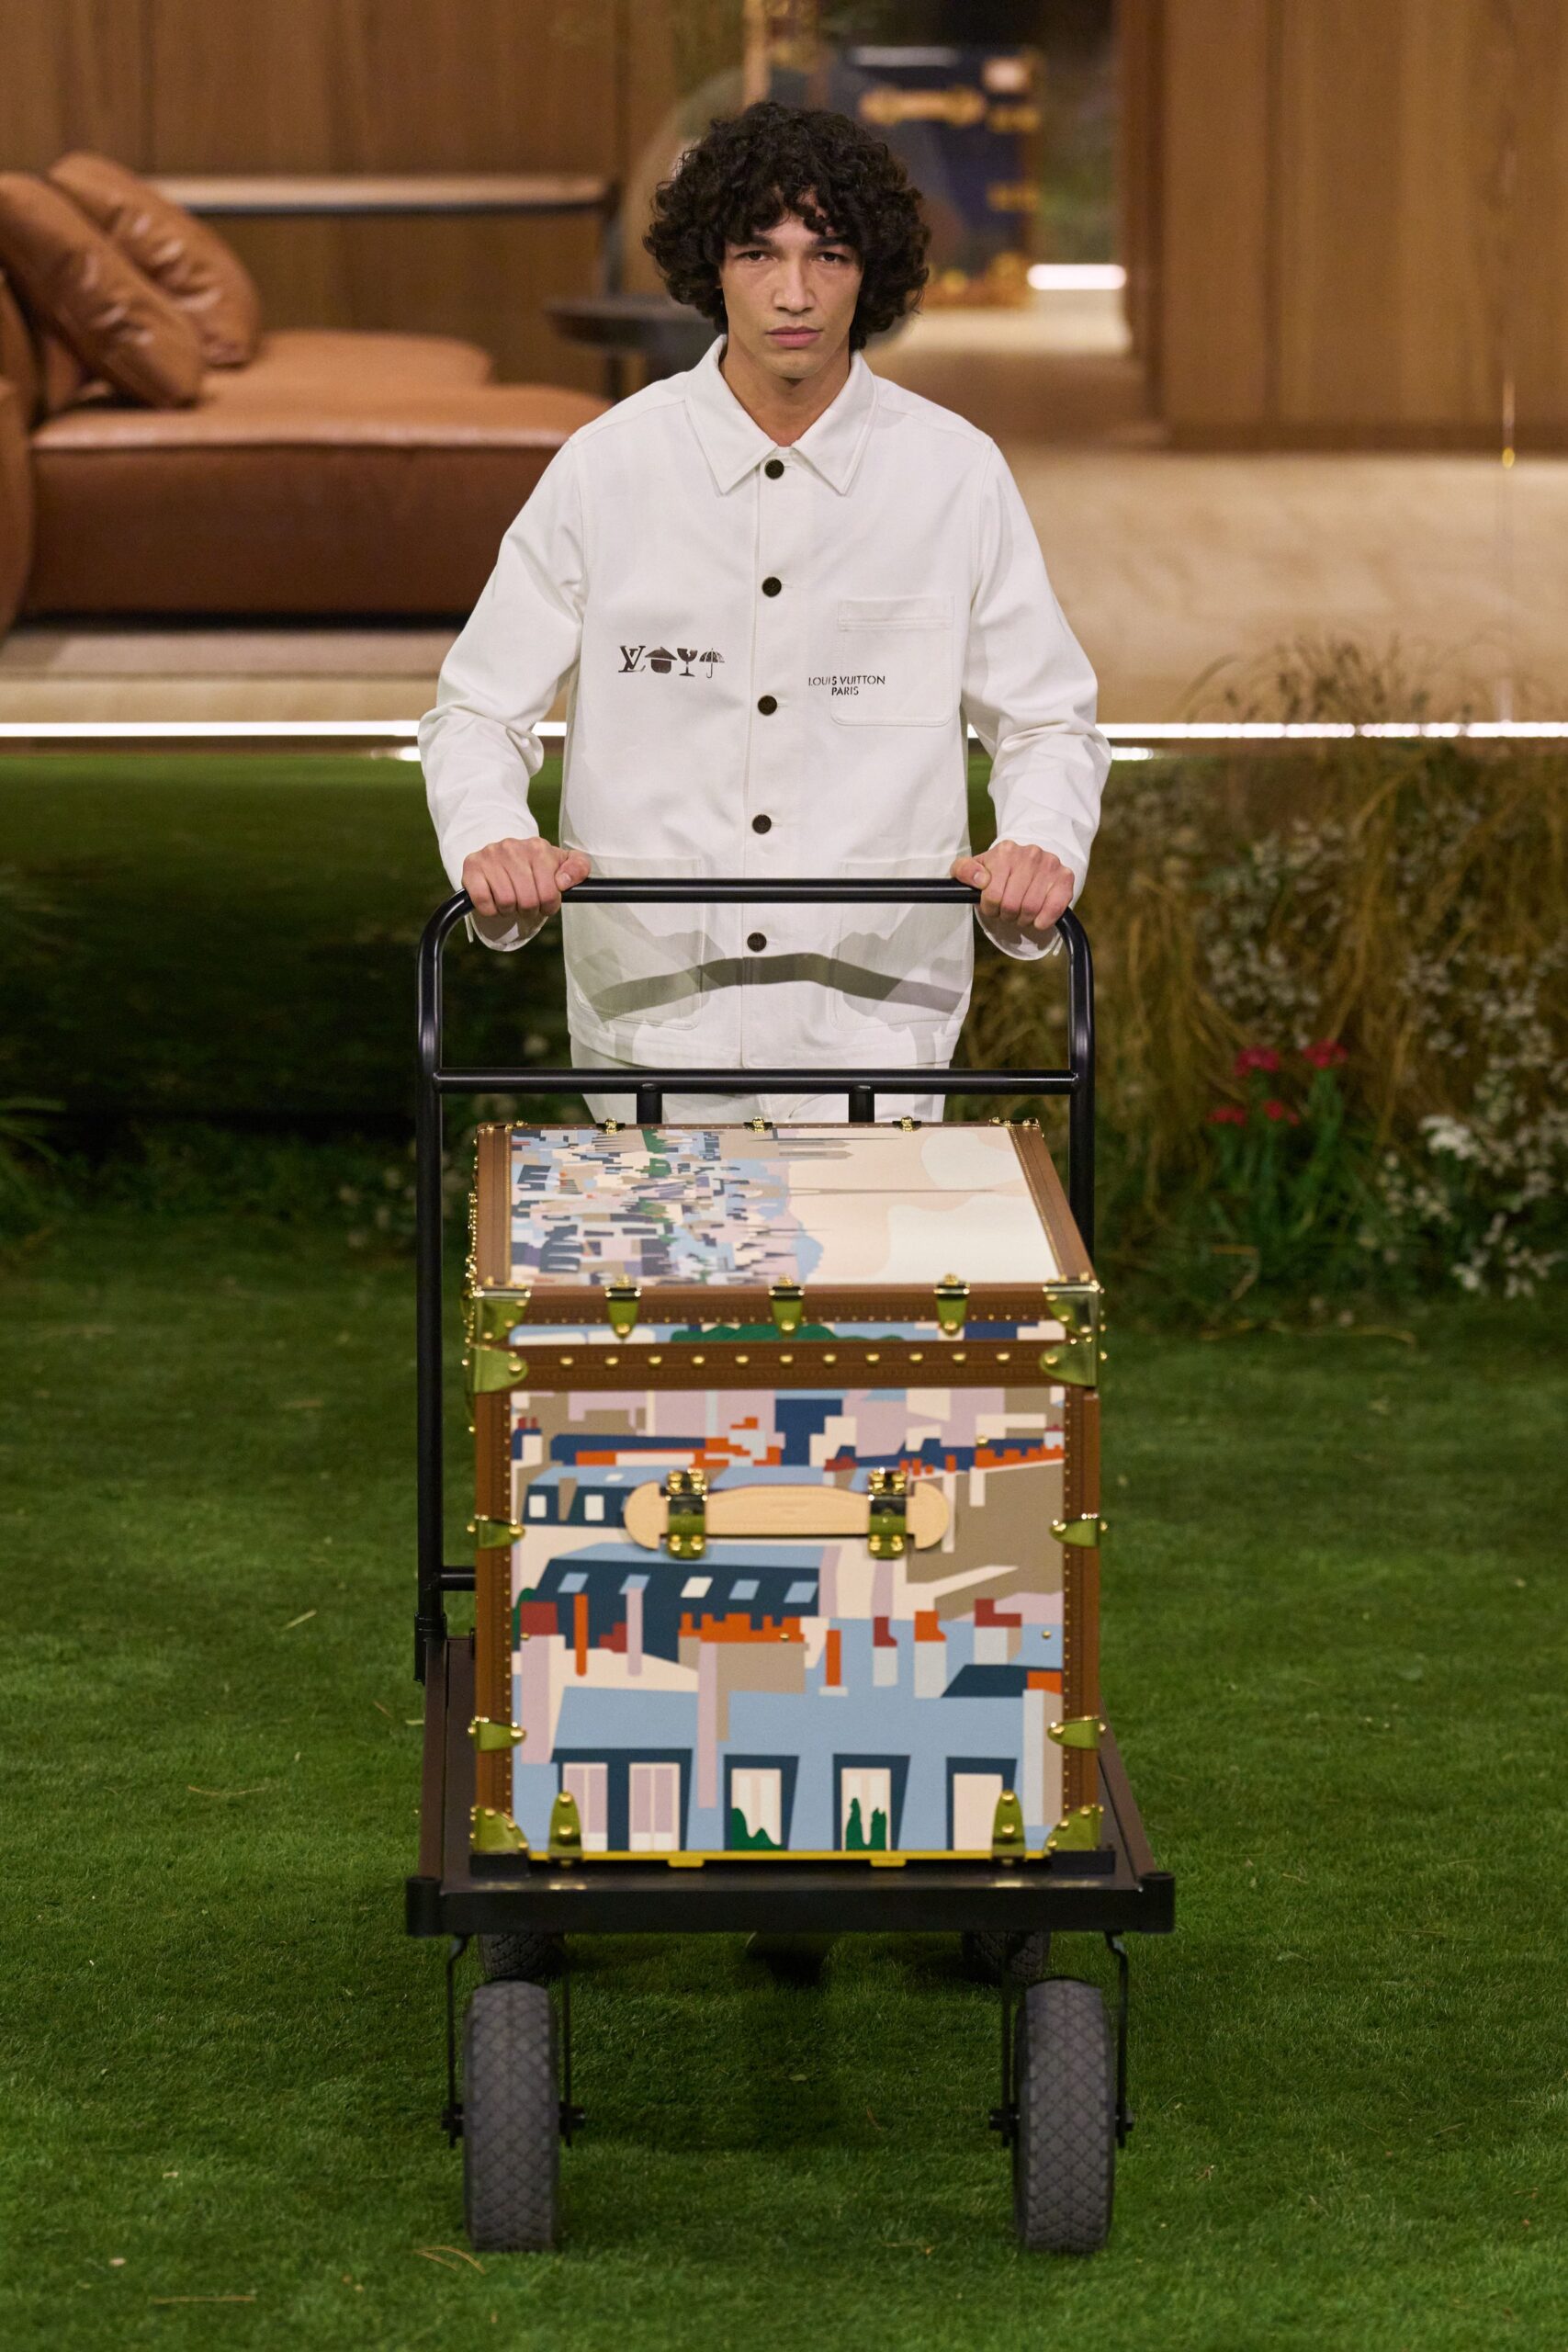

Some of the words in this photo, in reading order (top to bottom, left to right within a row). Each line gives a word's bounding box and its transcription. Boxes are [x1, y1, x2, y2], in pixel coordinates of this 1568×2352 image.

[808, 675, 838, 686] LOUIS
[840, 675, 886, 685] VUITTON
[831, 686, 859, 695] PARIS
